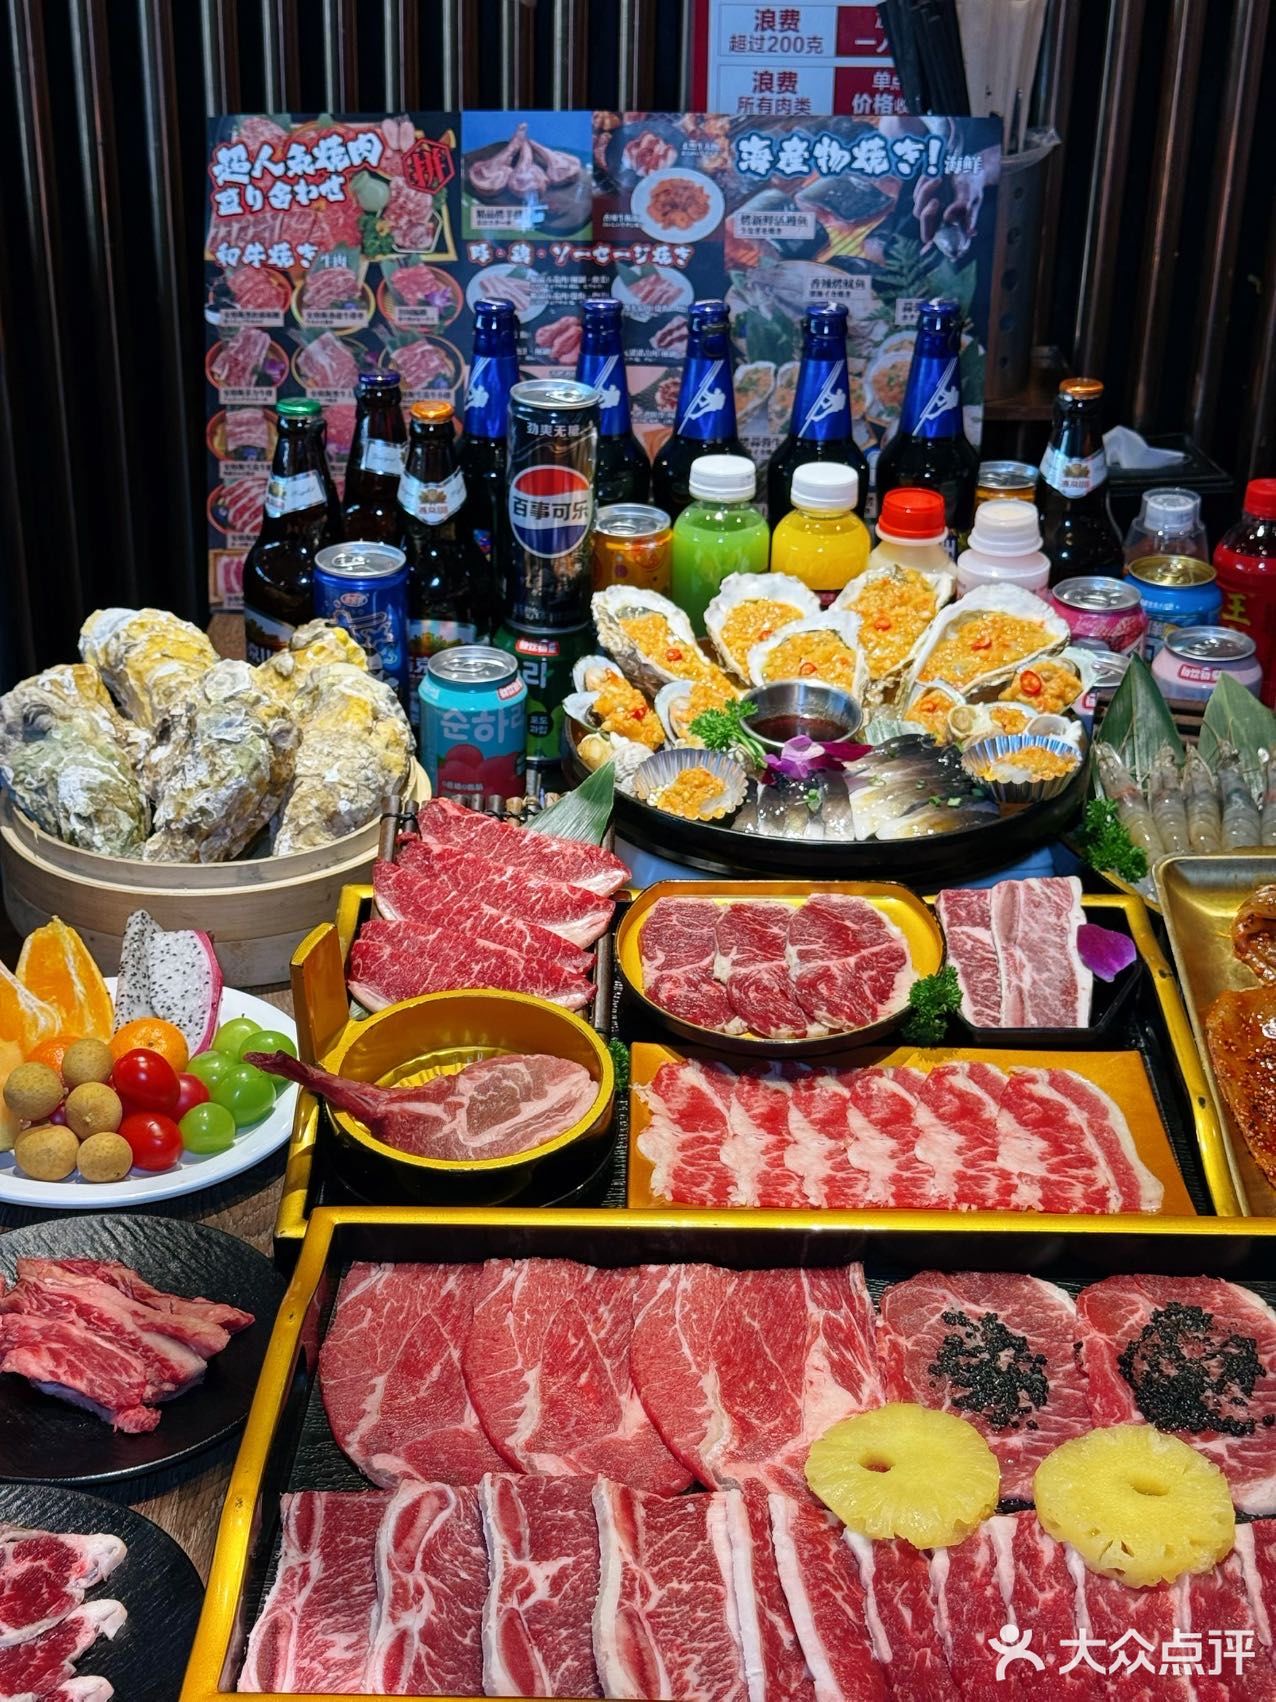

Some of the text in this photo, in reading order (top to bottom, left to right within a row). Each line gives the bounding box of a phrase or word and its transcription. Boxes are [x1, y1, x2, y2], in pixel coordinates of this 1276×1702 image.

[754, 9, 800, 33] 浪费
[729, 35, 824, 54] 超过200克
[752, 71, 798, 95] 浪费
[737, 97, 811, 115] 所有肉类
[526, 422, 580, 437] 劲爽无糖
[512, 498, 589, 521] 百事可乐
